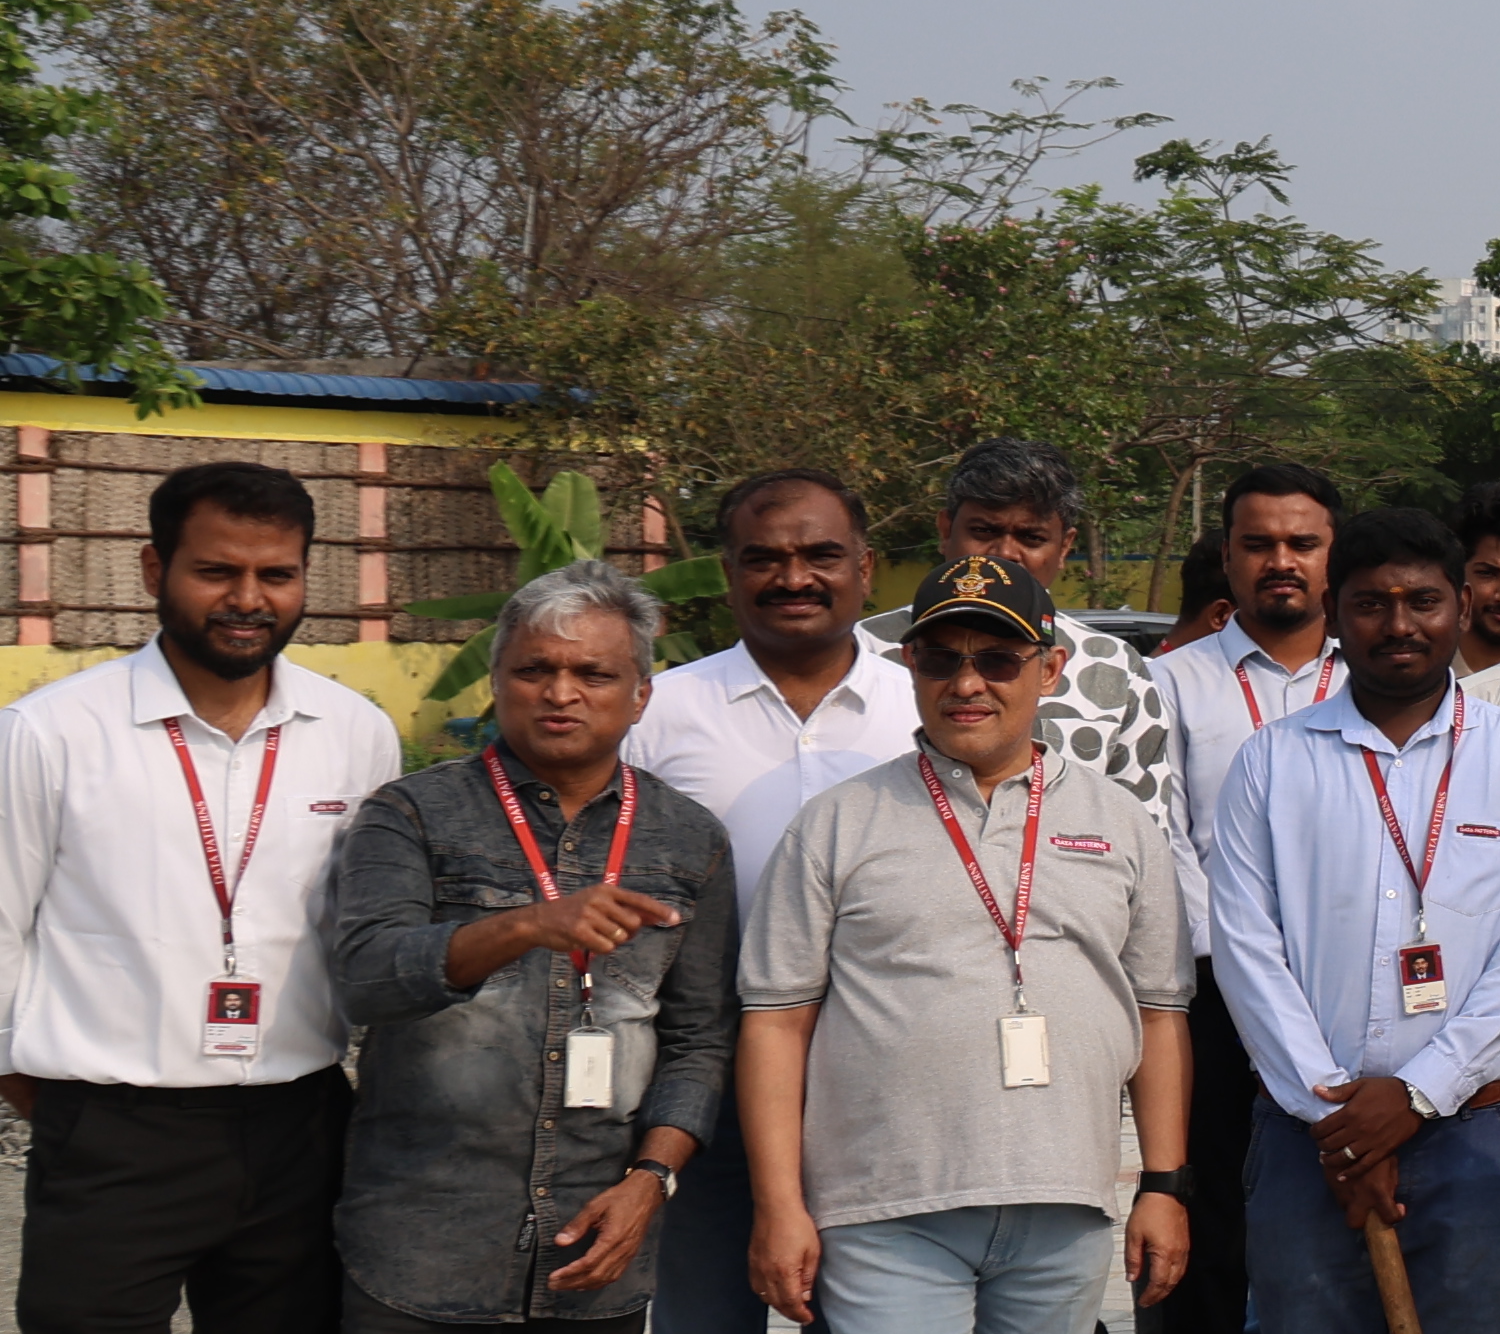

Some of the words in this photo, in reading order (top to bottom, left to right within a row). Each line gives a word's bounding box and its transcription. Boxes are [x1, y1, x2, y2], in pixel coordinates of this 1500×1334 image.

[505, 797, 527, 824] DATA
[618, 801, 635, 825] DATA
[935, 795, 953, 820] DATA
[1028, 794, 1041, 817] DATA
[1378, 795, 1400, 840] PATTERNS
[1430, 791, 1447, 839] PATTERNS
[194, 800, 218, 854] PATTERNS
[1054, 838, 1073, 847] DATA
[1074, 840, 1107, 850] PATTERNS
[1426, 838, 1438, 863] DATA
[208, 855, 225, 885] DATA
[966, 862, 996, 907] PATTERNS
[1018, 862, 1033, 907] PATTERNS
[990, 906, 1008, 934] DATA
[1016, 906, 1028, 935] DATA
